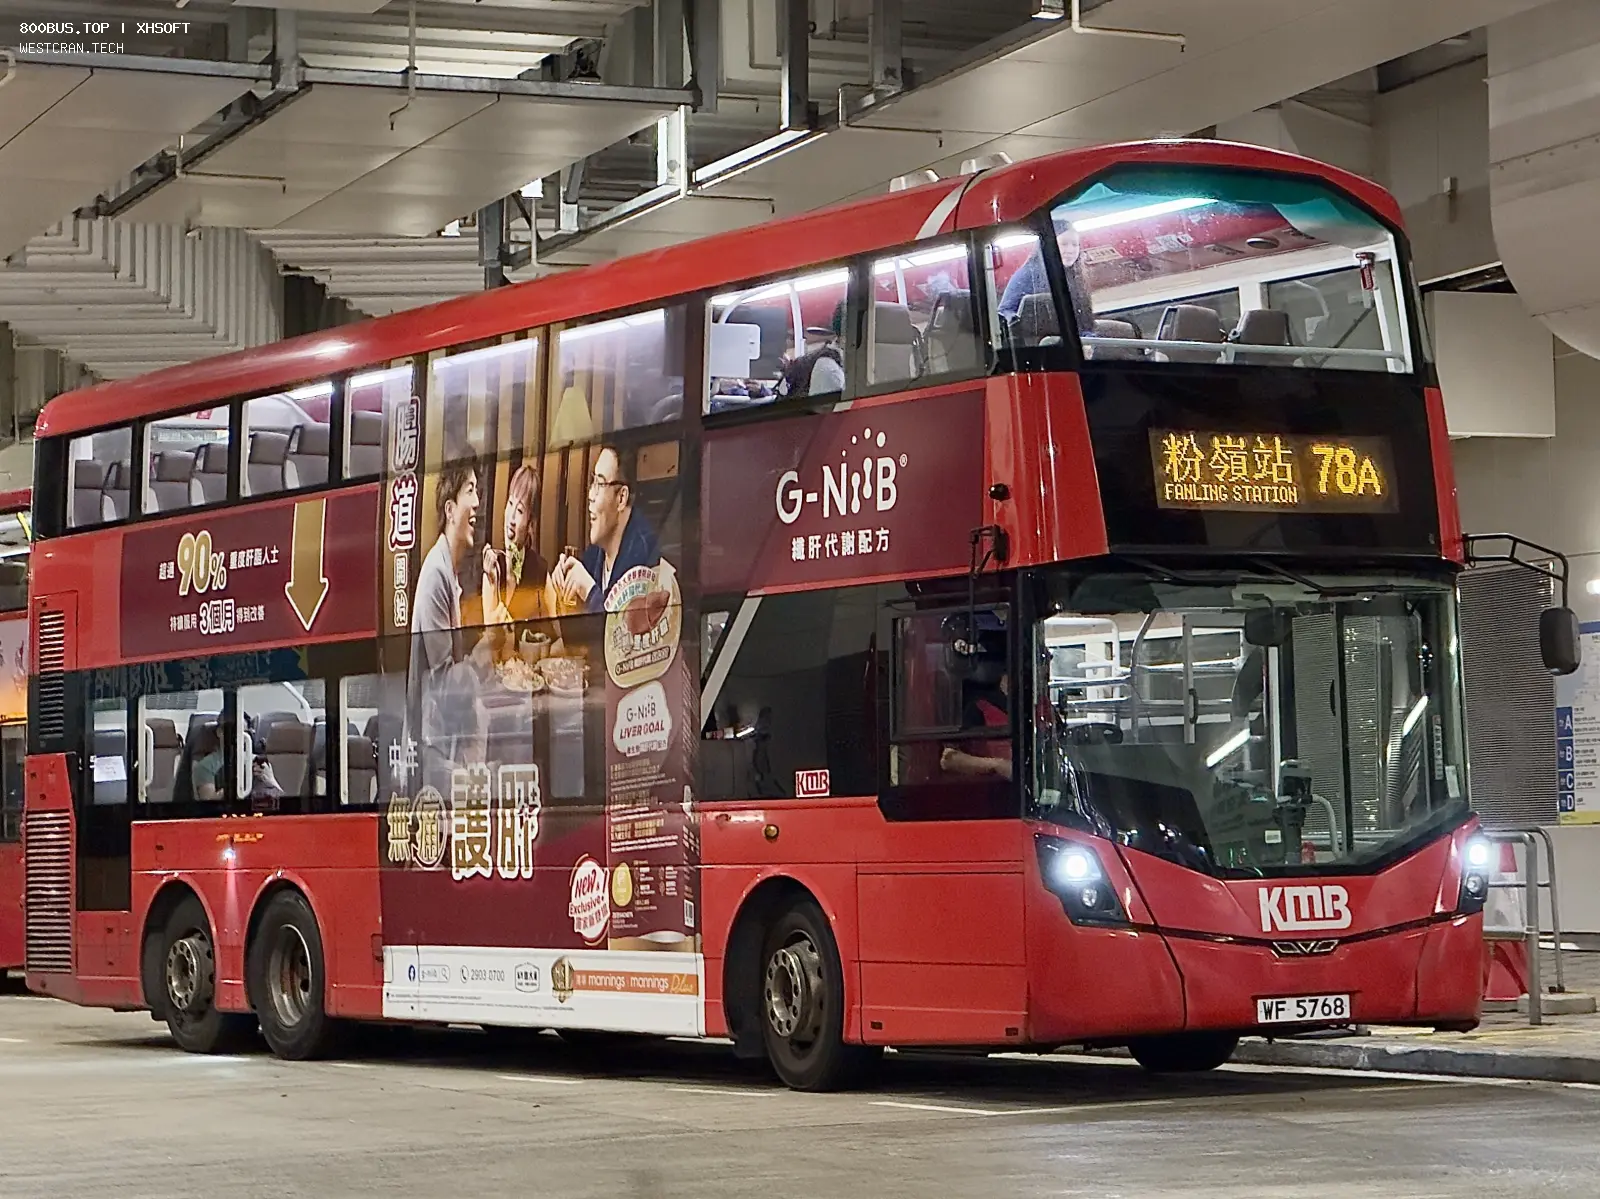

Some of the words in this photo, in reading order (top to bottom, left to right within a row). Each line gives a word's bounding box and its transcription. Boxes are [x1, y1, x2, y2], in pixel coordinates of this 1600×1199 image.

[1161, 433, 1293, 484] 粉嶺站
[1312, 445, 1382, 495] 78A
[1164, 483, 1229, 502] FANLING
[1232, 485, 1298, 503] STATION
[619, 725, 643, 740] LIVER
[643, 719, 665, 735] GOAL
[1563, 714, 1573, 731] A
[1565, 745, 1573, 762] B
[796, 770, 829, 796] KMB
[1566, 772, 1574, 789] C
[1566, 796, 1574, 811] D
[1258, 885, 1352, 933] KMB
[470, 969, 487, 981] 2903
[488, 969, 505, 982] 0700
[588, 973, 626, 992] mannings
[630, 975, 669, 993] mannings
[1262, 1000, 1287, 1021] WF
[1295, 997, 1345, 1019] 5768
